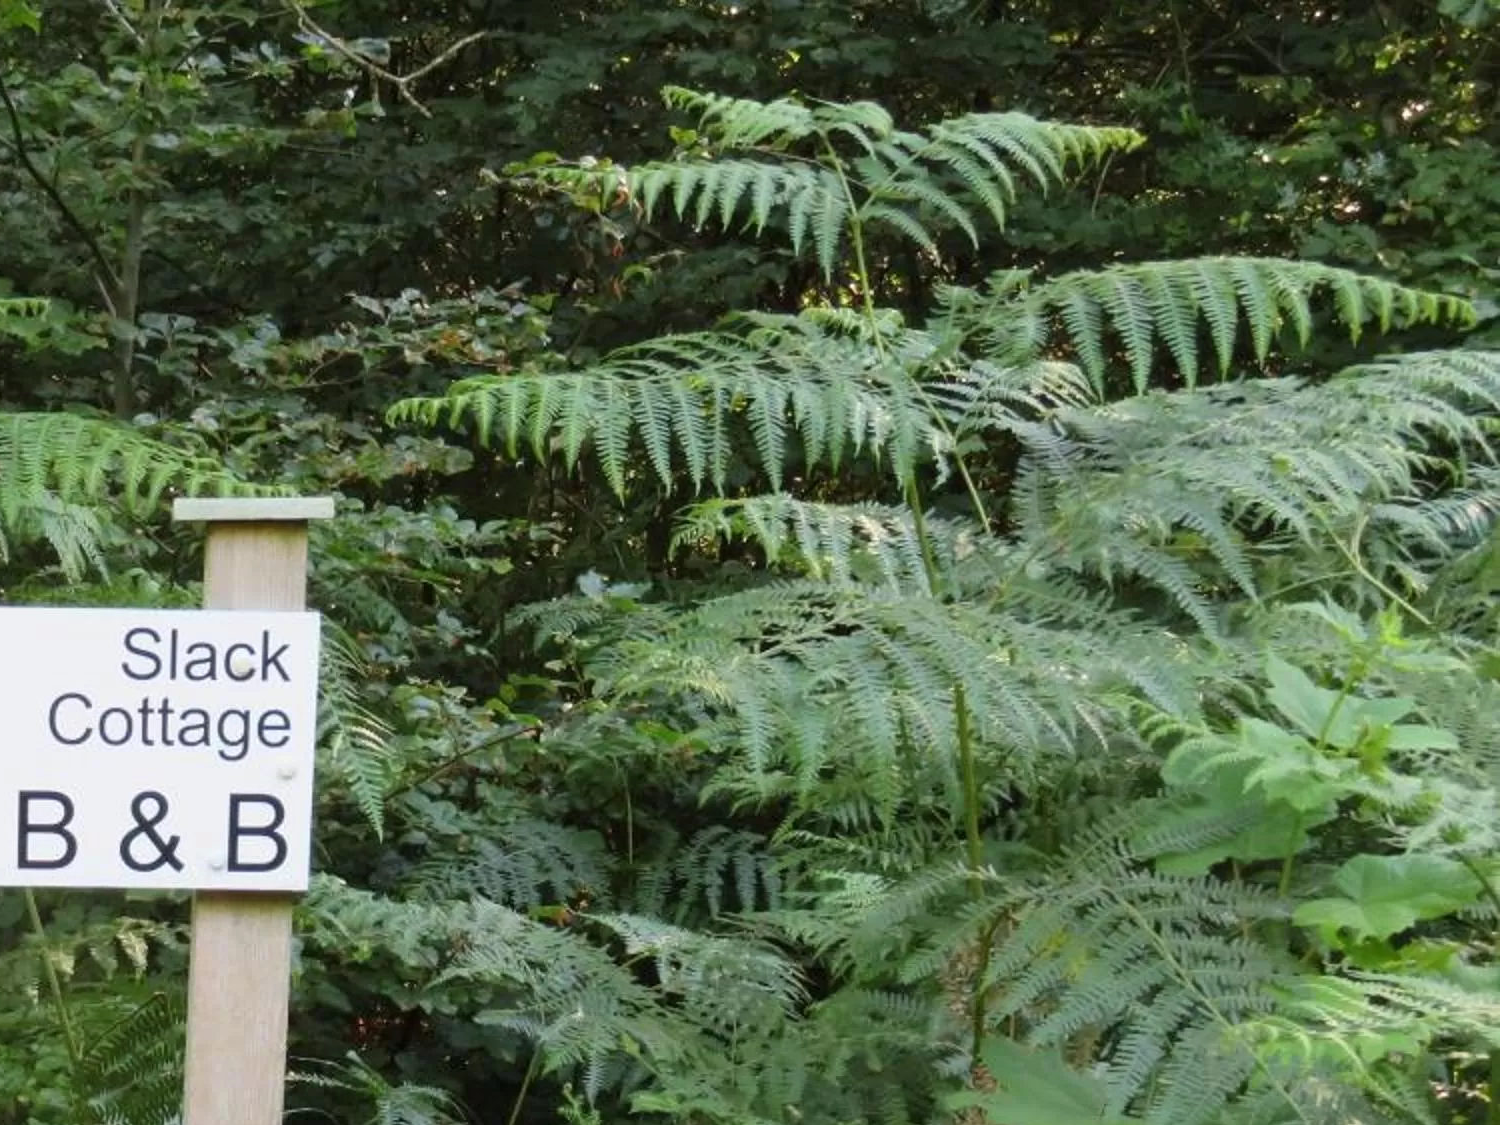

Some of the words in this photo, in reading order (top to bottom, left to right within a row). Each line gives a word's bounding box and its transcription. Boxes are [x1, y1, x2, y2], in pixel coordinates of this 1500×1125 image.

[122, 627, 290, 682] Slack
[49, 693, 291, 761] Cottage
[17, 790, 77, 870] B
[119, 791, 185, 872] &
[227, 793, 287, 872] B
